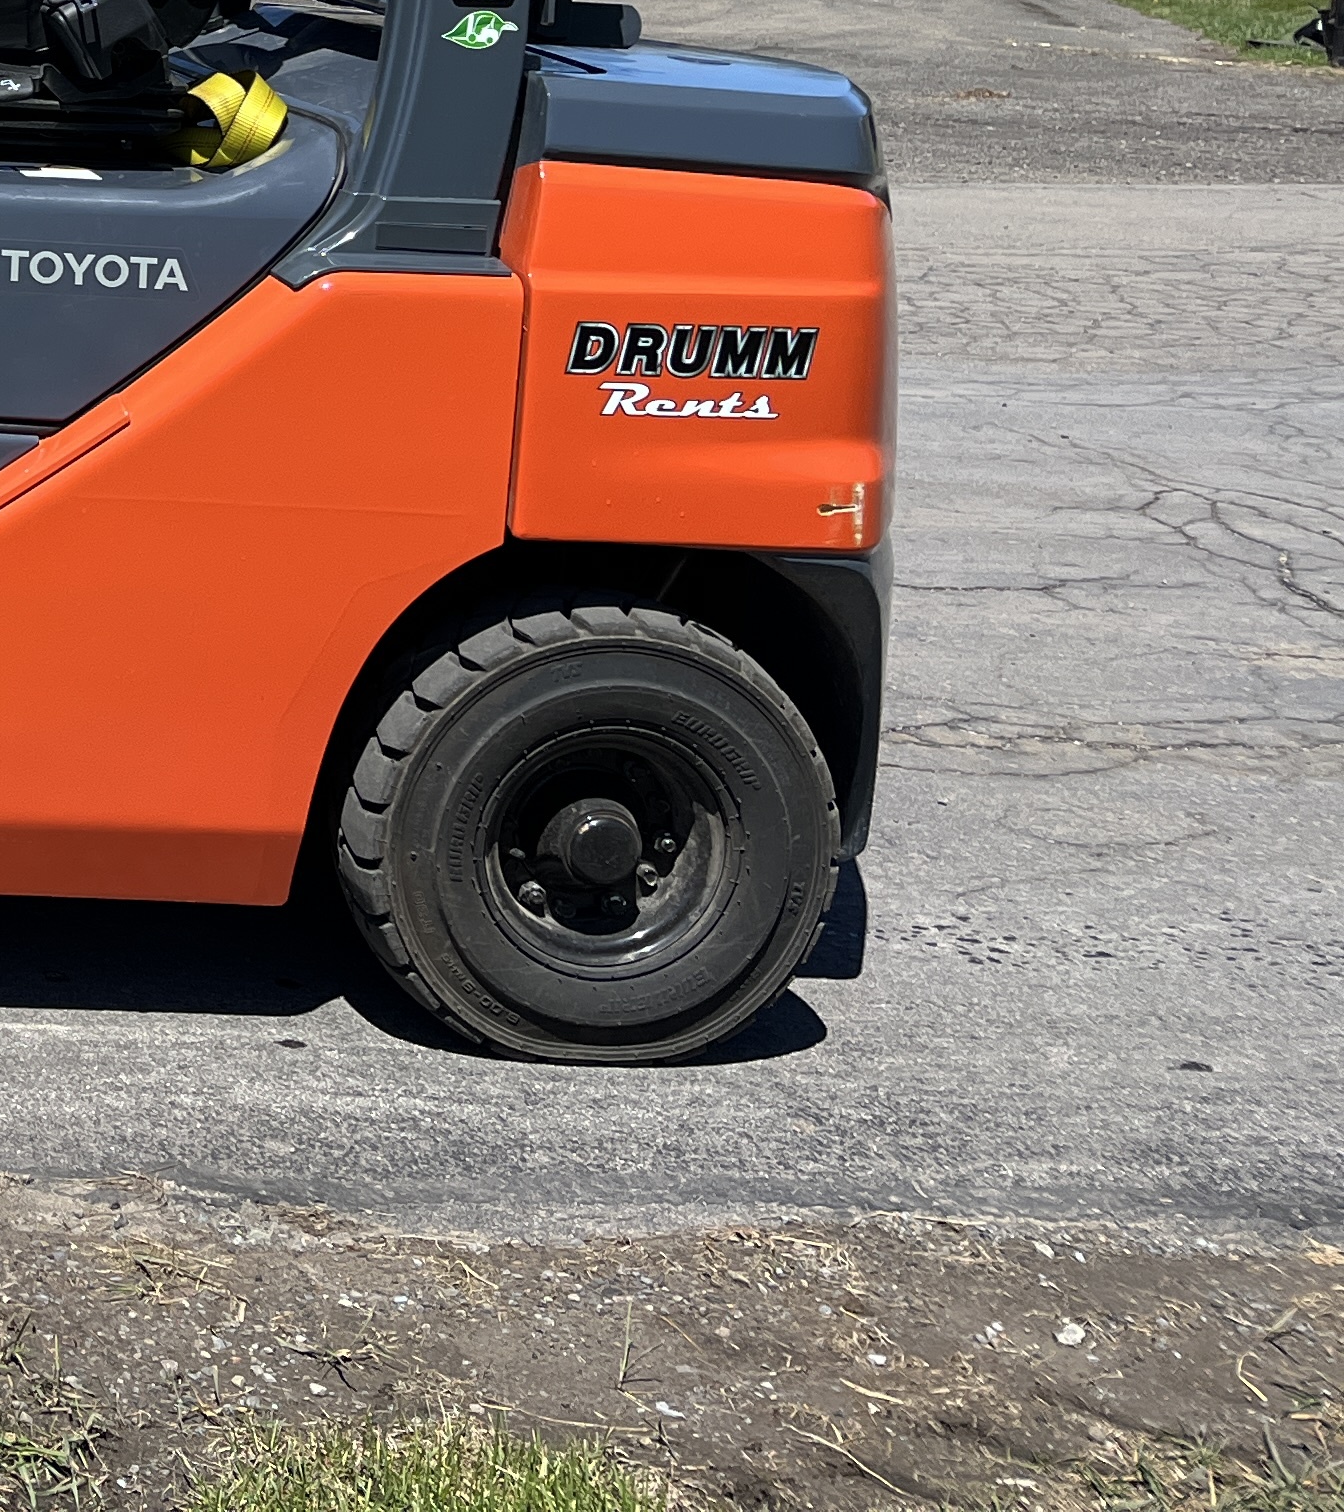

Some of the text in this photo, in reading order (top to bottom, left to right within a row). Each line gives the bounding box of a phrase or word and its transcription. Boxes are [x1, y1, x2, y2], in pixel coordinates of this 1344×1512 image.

[1, 248, 189, 292] TOYOTA
[564, 321, 821, 381] DRUMM
[597, 381, 781, 420] Rents
